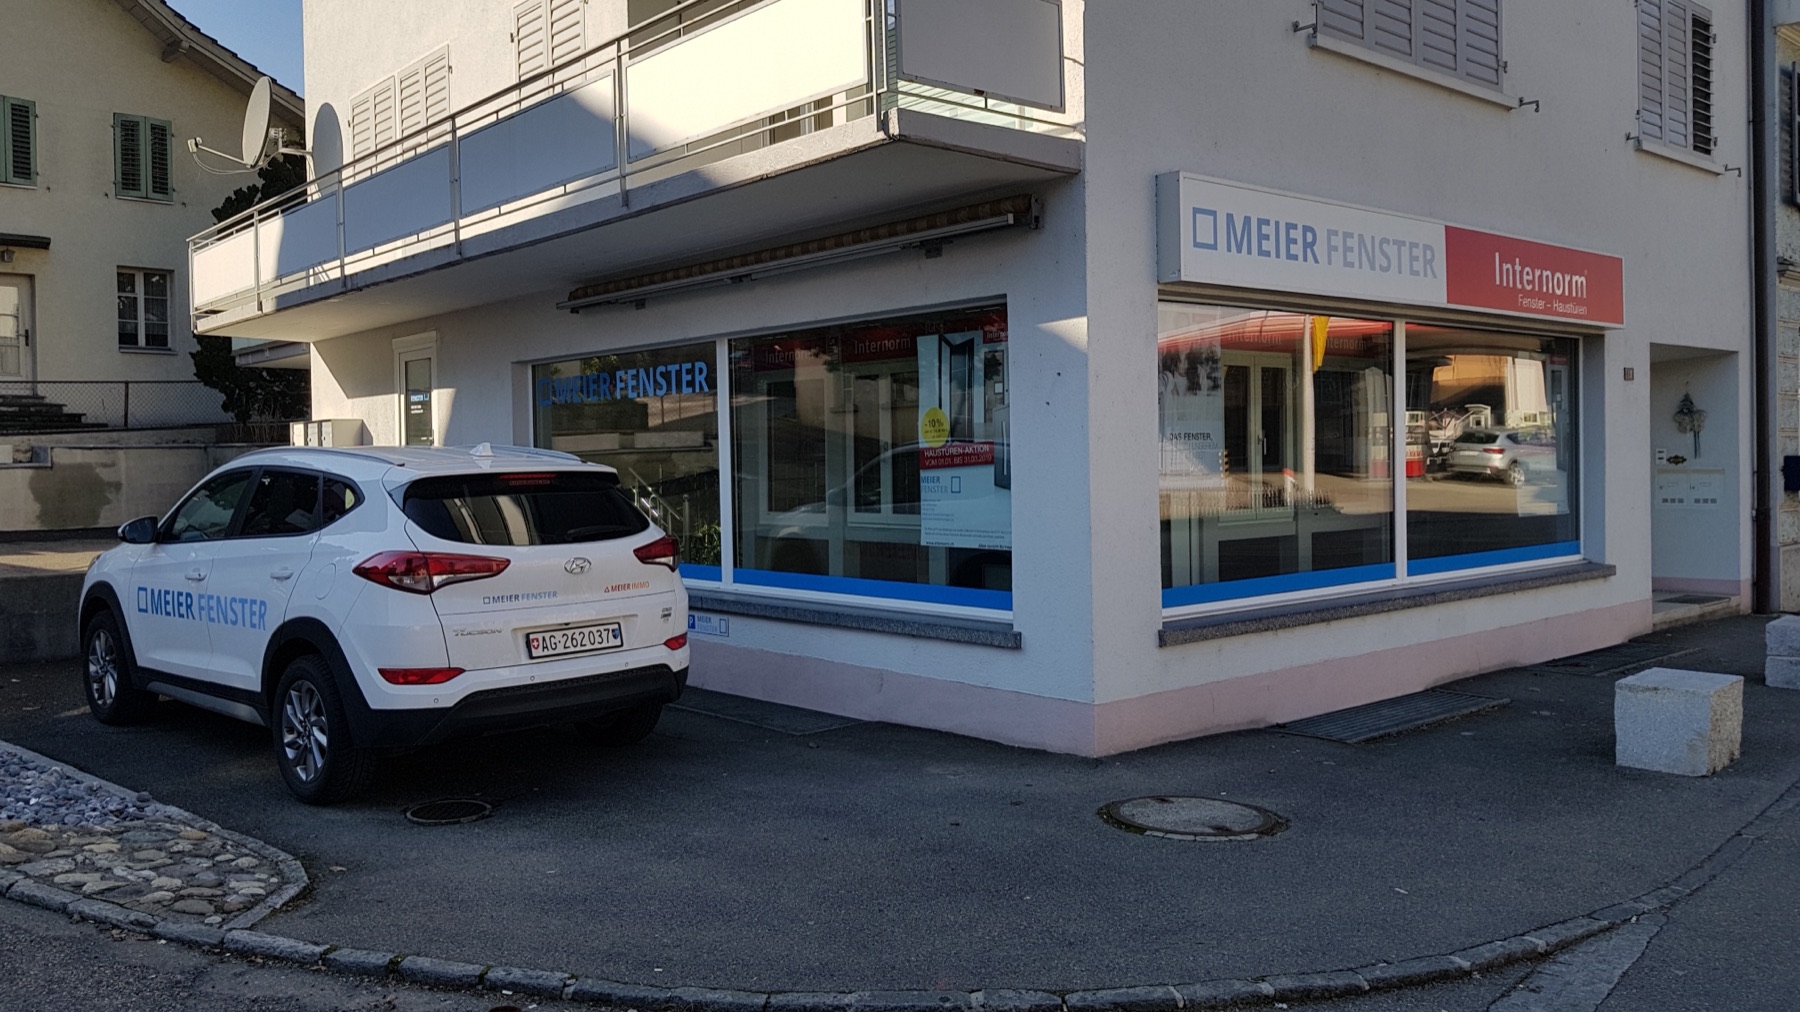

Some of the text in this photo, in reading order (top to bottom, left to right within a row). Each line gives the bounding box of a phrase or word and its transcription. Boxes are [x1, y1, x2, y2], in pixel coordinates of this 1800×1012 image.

[1226, 212, 1438, 279] MEIER FENSTER
[1495, 252, 1587, 298] Internorm
[1518, 294, 1545, 310] Fenster
[1553, 299, 1588, 315] Haustüren
[854, 337, 911, 354] Internorm
[555, 361, 709, 404] MEIER FENSTER
[925, 458, 938, 466] VOM
[953, 456, 963, 464] BIS
[920, 475, 941, 485] MEIER
[611, 580, 650, 592] MEIER IMMO
[492, 590, 558, 604] MEIER FENSTER
[150, 588, 267, 631] MEIER FENSTER
